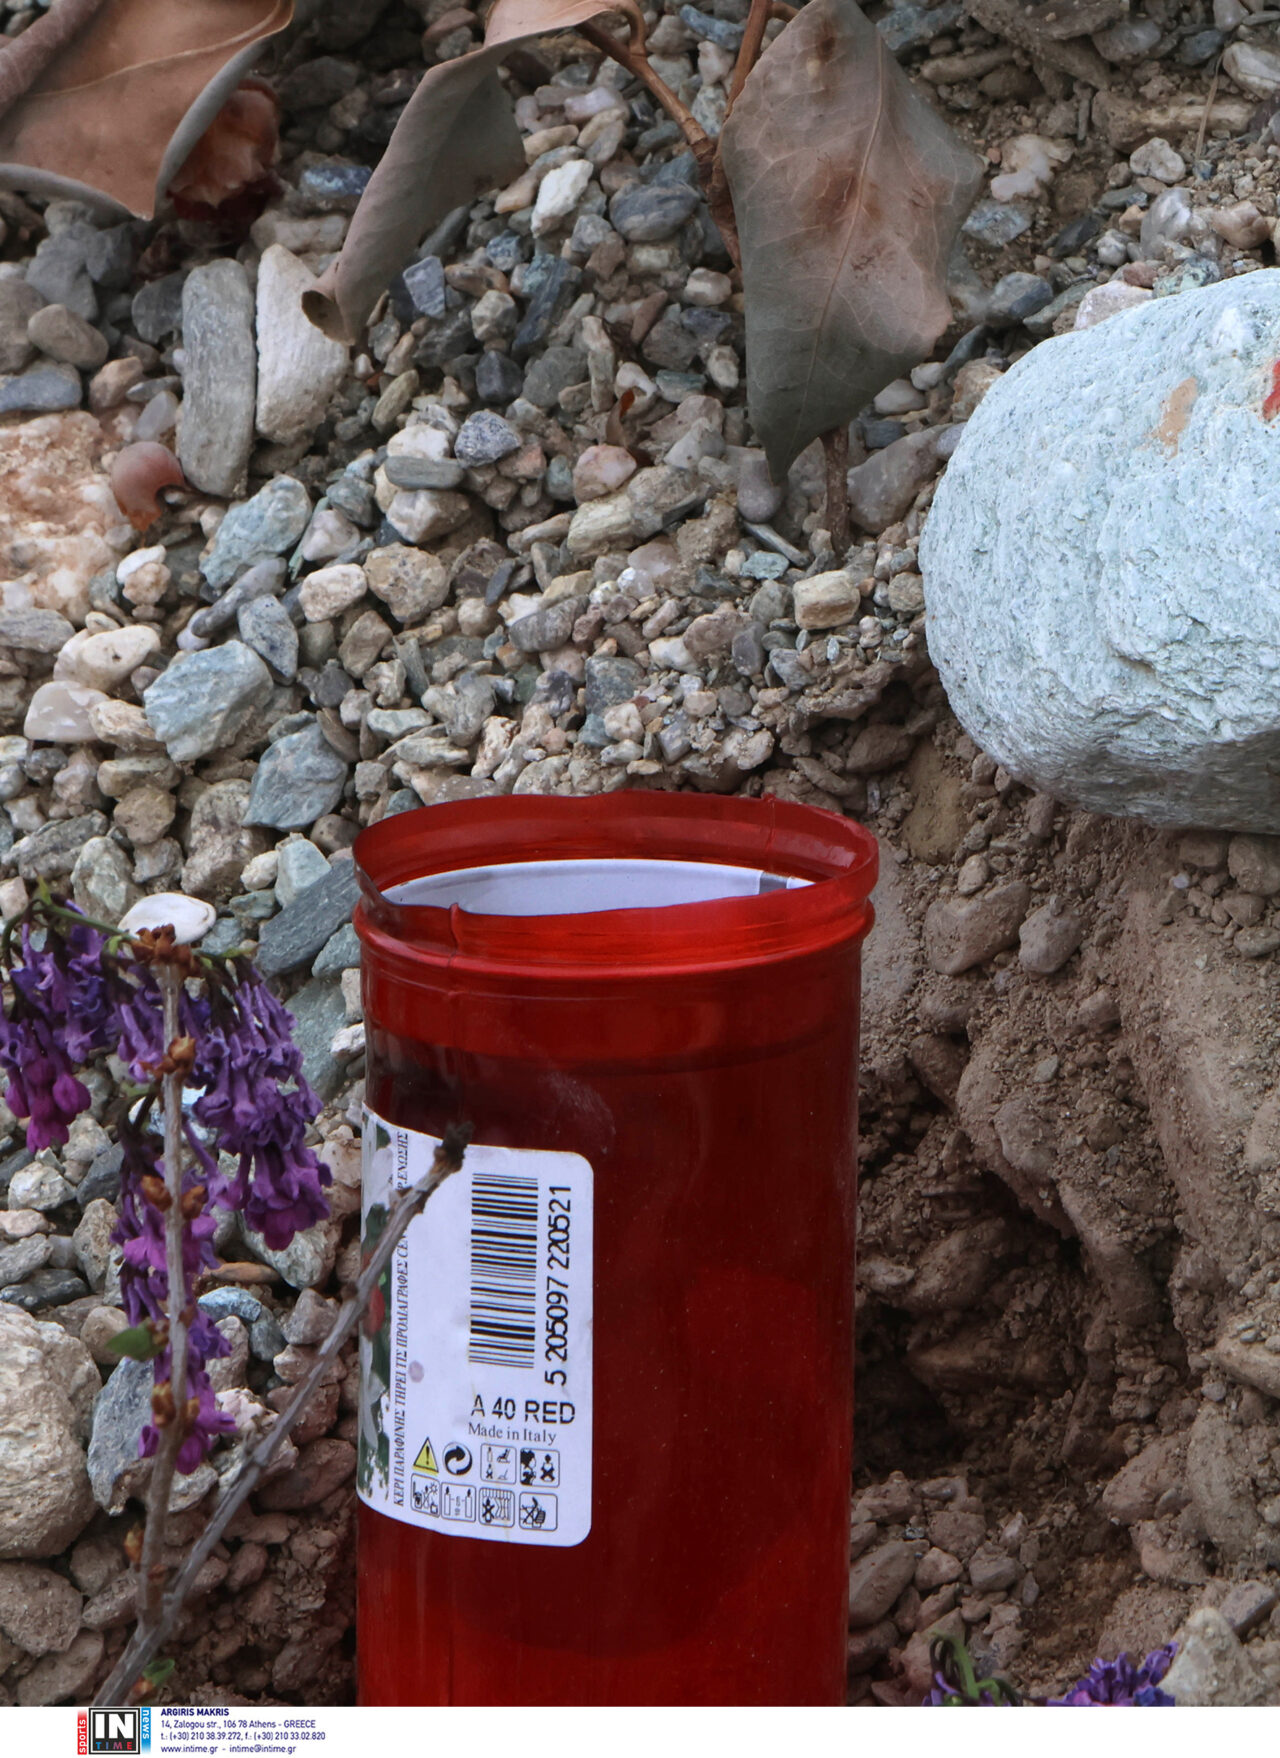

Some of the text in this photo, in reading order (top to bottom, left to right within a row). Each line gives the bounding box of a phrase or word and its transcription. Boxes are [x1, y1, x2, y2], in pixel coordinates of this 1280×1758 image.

[544, 1186, 571, 1386] 5 205097 220521
[396, 1349, 408, 1368] ΤΙΣ
[395, 1371, 407, 1405] ΤΗΡΕΙ
[471, 1394, 575, 1424] A 40 RED
[394, 1409, 405, 1477] ΠΑΡΑΦΙΝΗΣ
[468, 1422, 556, 1446] Made in Italy
[393, 1478, 404, 1506] ΚΕΡΙ
